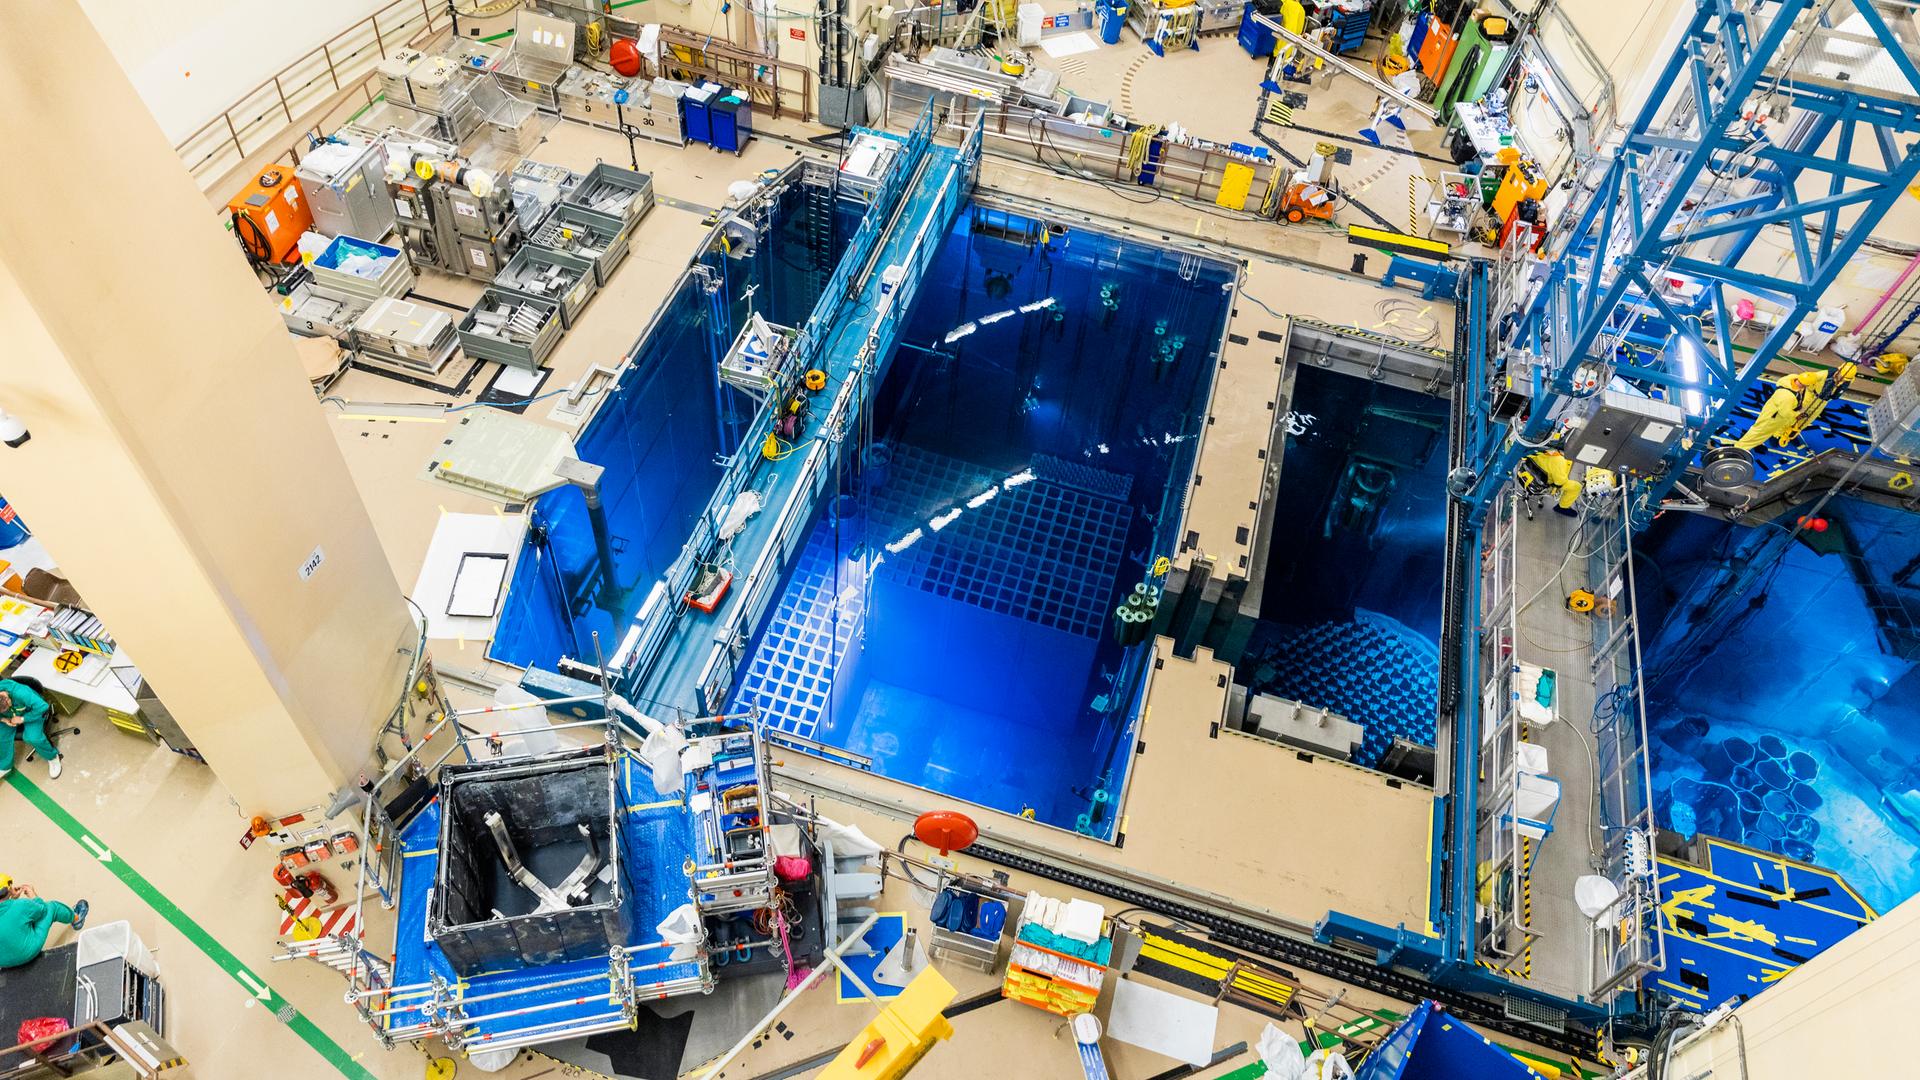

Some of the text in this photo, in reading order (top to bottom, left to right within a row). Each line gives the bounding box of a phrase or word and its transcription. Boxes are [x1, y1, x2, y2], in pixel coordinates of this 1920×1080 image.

[520, 85, 528, 94] 4
[584, 104, 592, 113] 9
[642, 117, 655, 127] 30
[306, 320, 314, 330] 3
[305, 554, 322, 577] 2142
